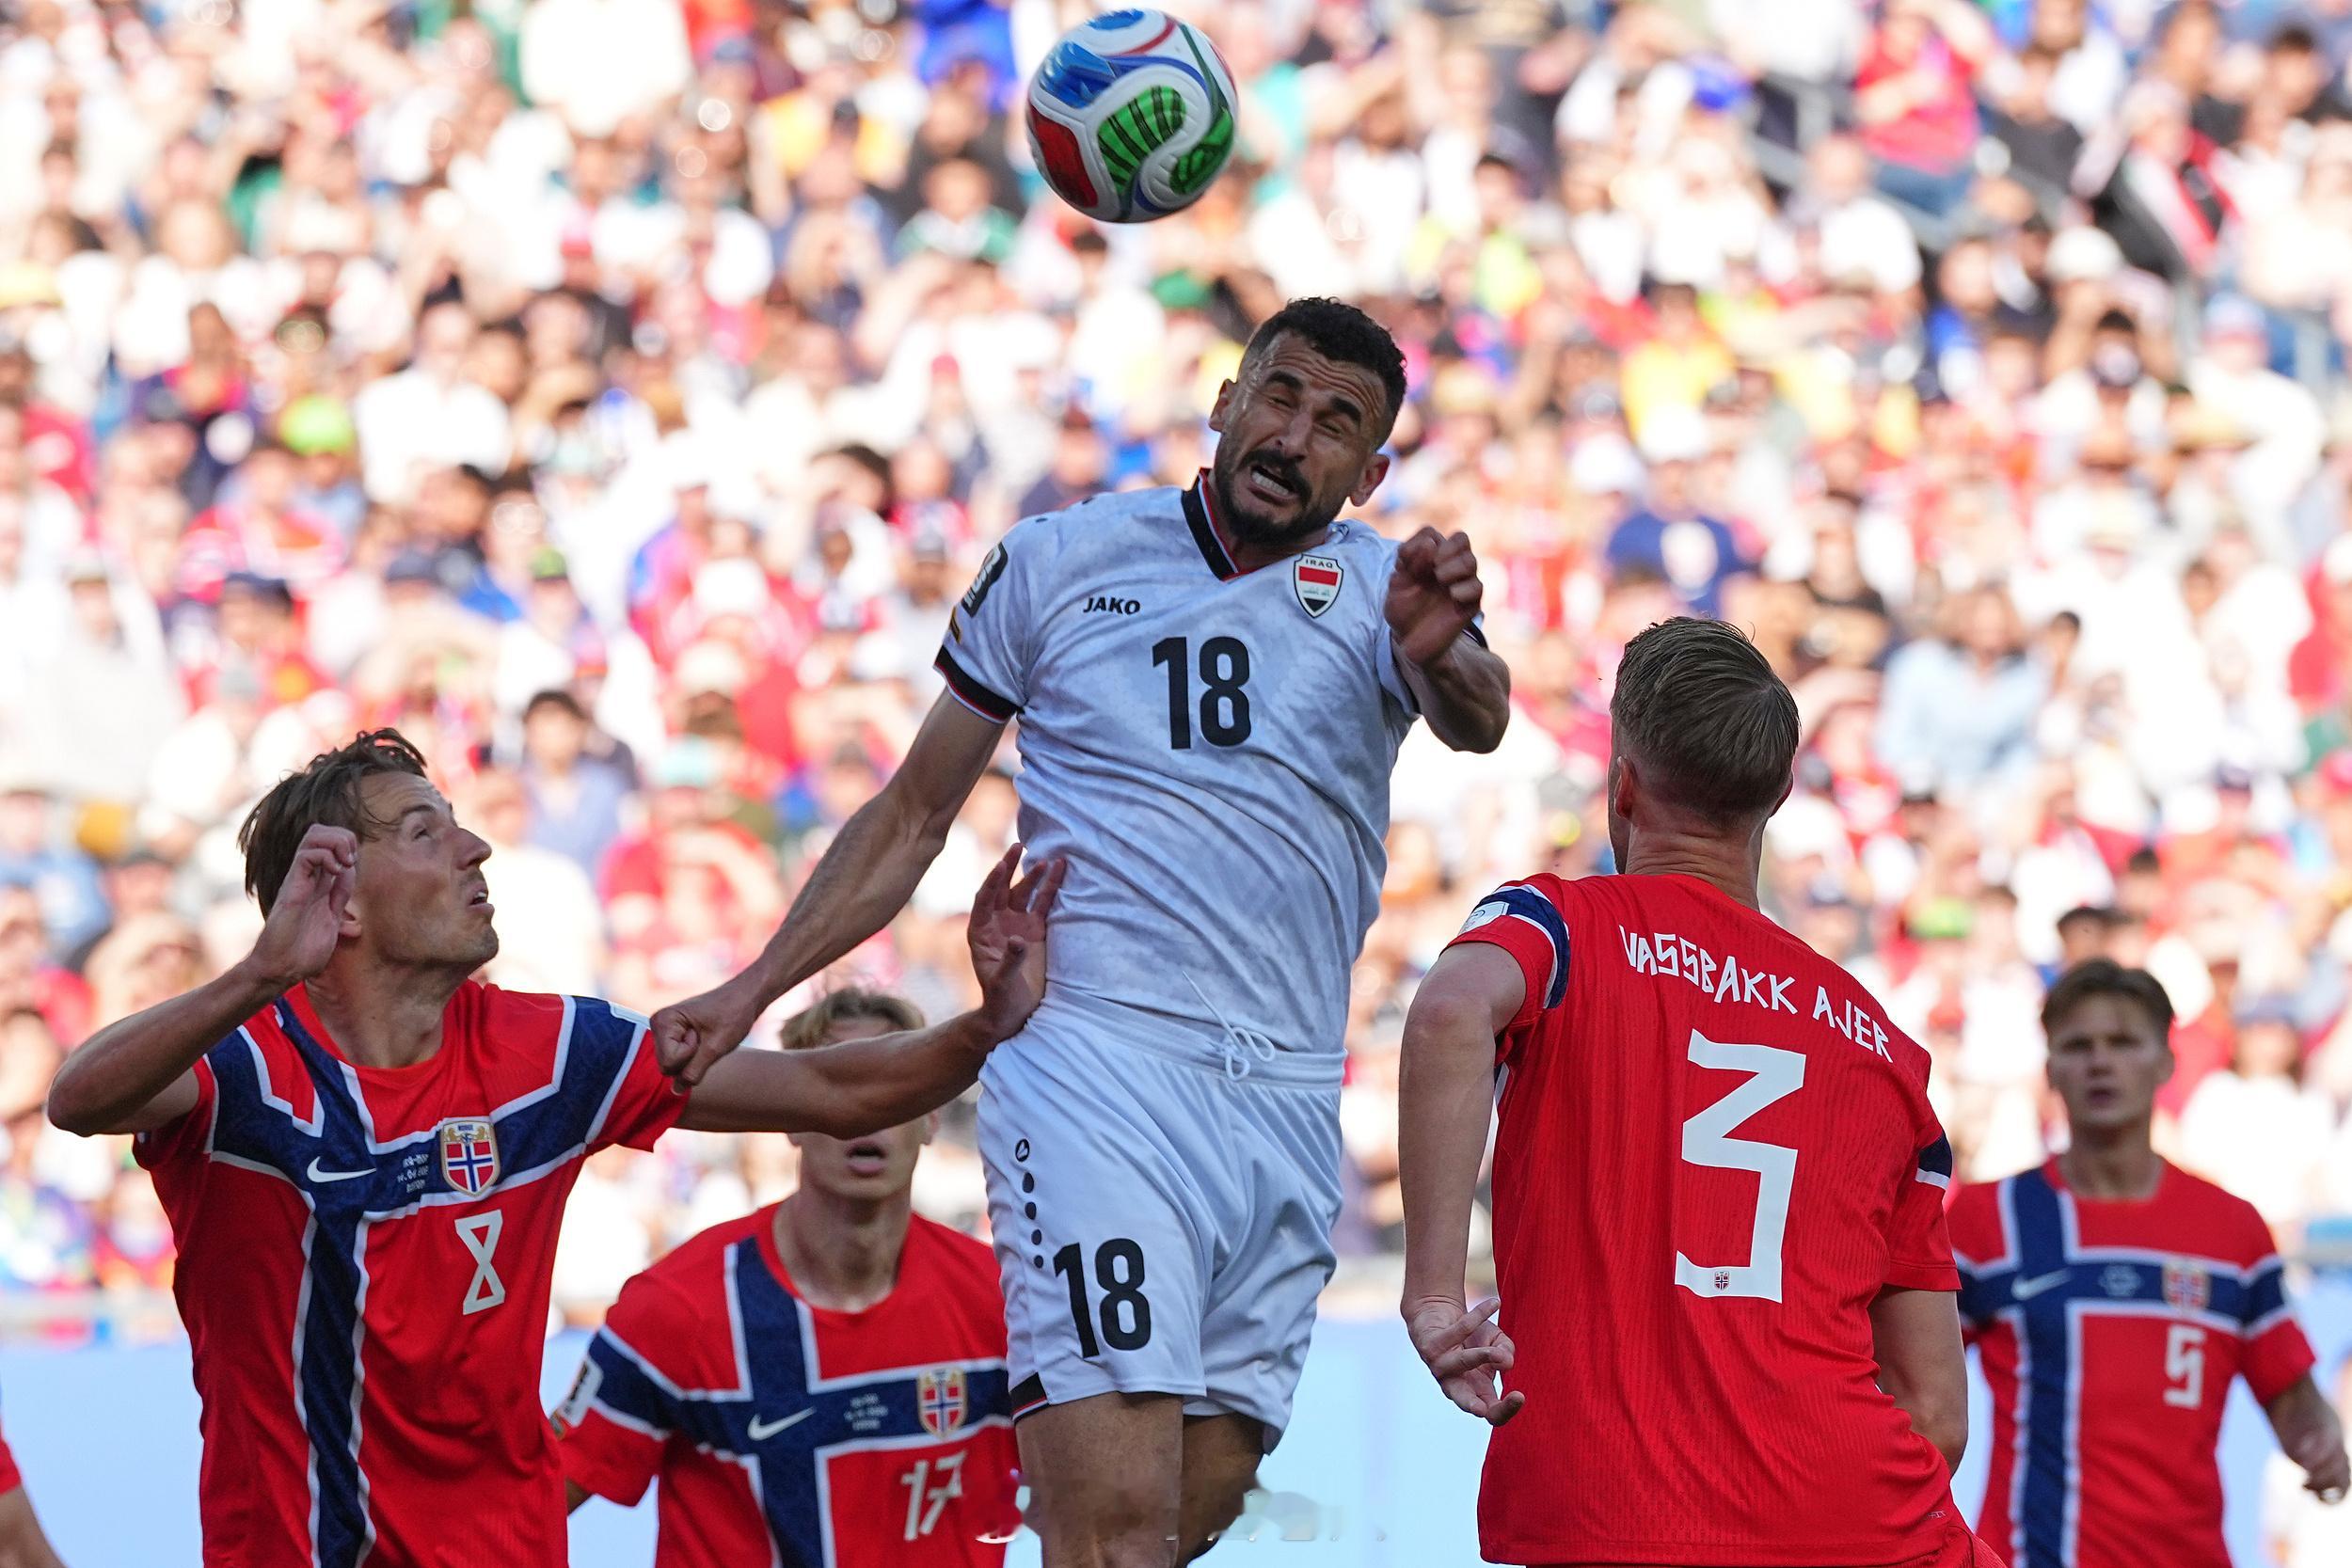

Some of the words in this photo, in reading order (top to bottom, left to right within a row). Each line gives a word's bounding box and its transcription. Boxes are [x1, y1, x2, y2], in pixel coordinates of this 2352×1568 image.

[1083, 596, 1140, 615] JAKO
[1305, 558, 1333, 569] IRAQ
[1152, 636, 1251, 750] 18
[1619, 925, 1798, 1015] VASSBAKK
[1812, 985, 1894, 1063] AJER
[1675, 1028, 1806, 1304] 3
[453, 1208, 505, 1316] 8
[1053, 1237, 1152, 1359] 18
[2164, 1326, 2207, 1409] 5
[901, 1449, 968, 1541] 17
